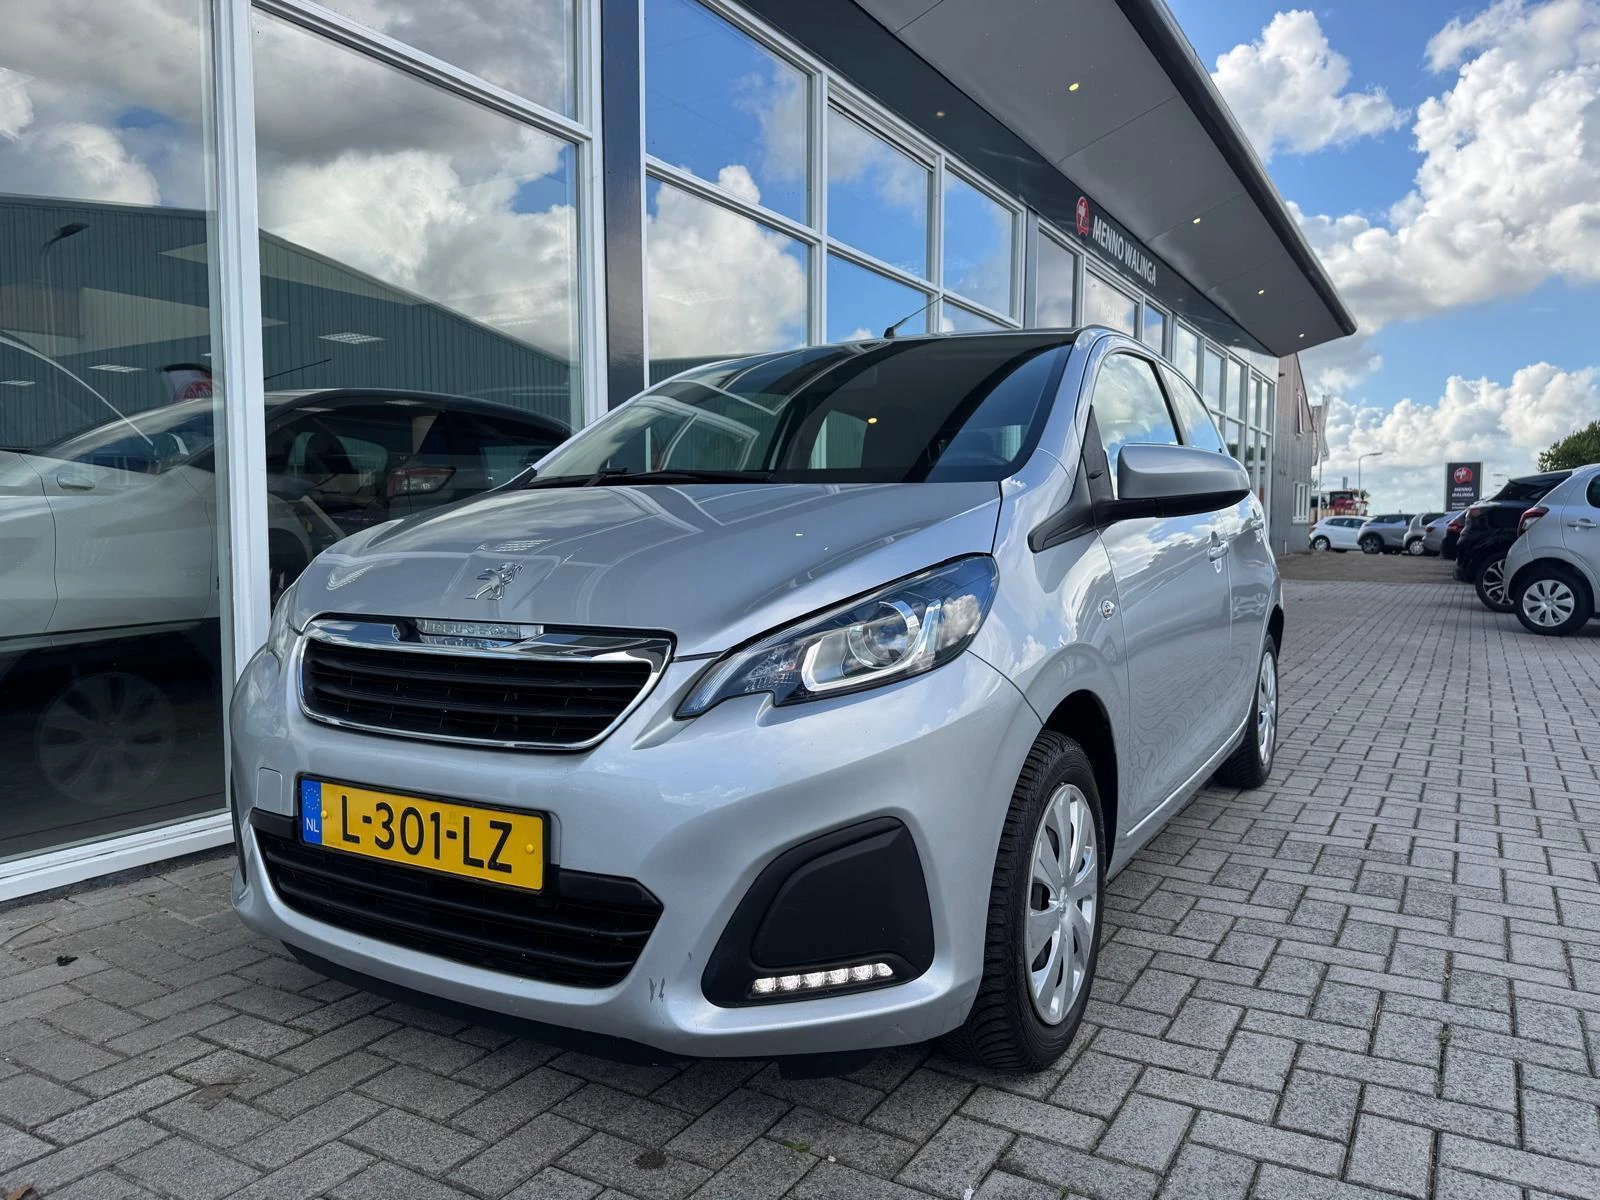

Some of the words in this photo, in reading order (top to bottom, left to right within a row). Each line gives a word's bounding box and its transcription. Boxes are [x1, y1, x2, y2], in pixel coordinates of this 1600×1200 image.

[1092, 215, 1124, 260] MENNO
[1124, 241, 1156, 287] WALINGA
[305, 817, 320, 834] NL
[341, 795, 513, 874] L-301-LZ
